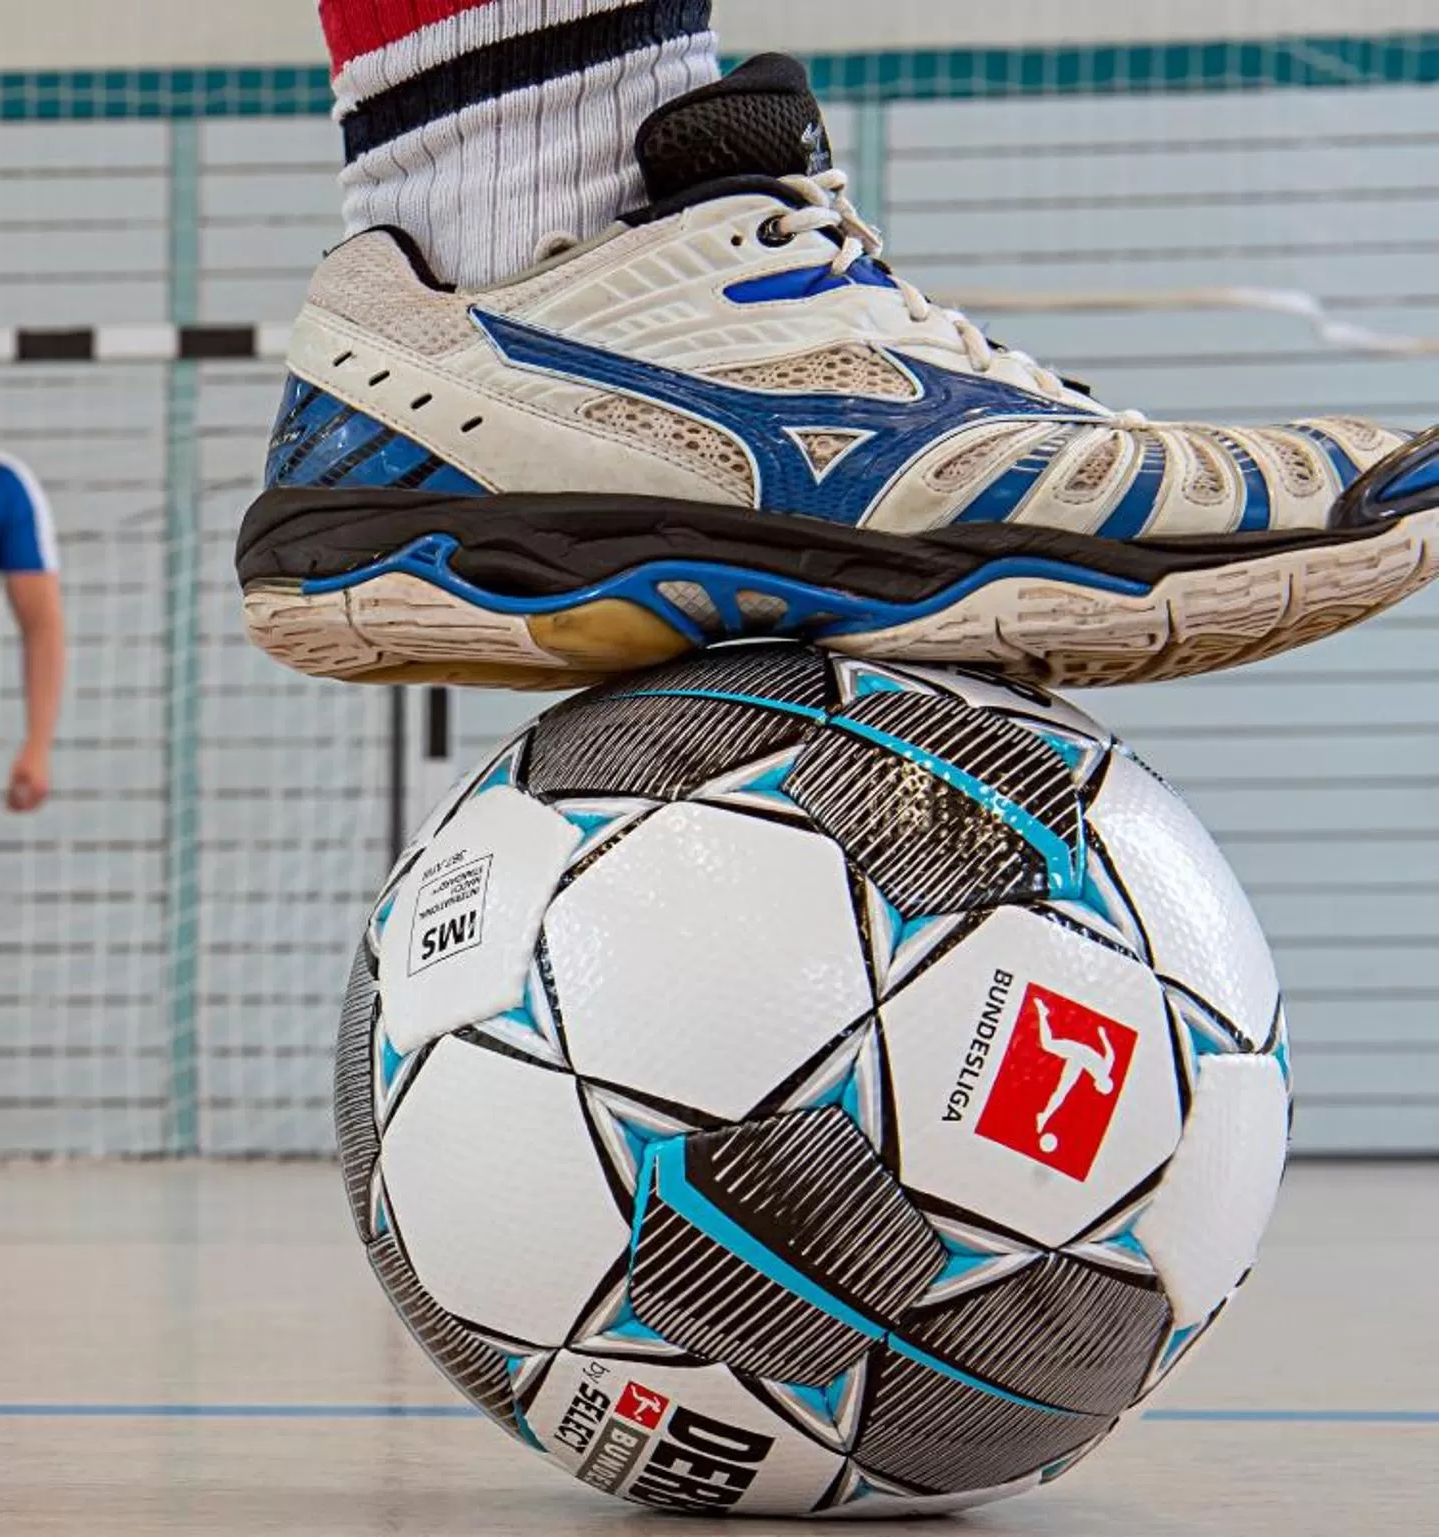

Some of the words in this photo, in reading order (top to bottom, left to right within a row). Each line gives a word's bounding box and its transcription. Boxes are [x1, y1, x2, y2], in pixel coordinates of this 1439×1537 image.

[422, 910, 477, 960] IMS
[941, 968, 1014, 1122] BUNDESLIGA
[582, 1360, 610, 1384] by
[554, 1382, 610, 1453] SELECT
[623, 1405, 776, 1516] DERB
